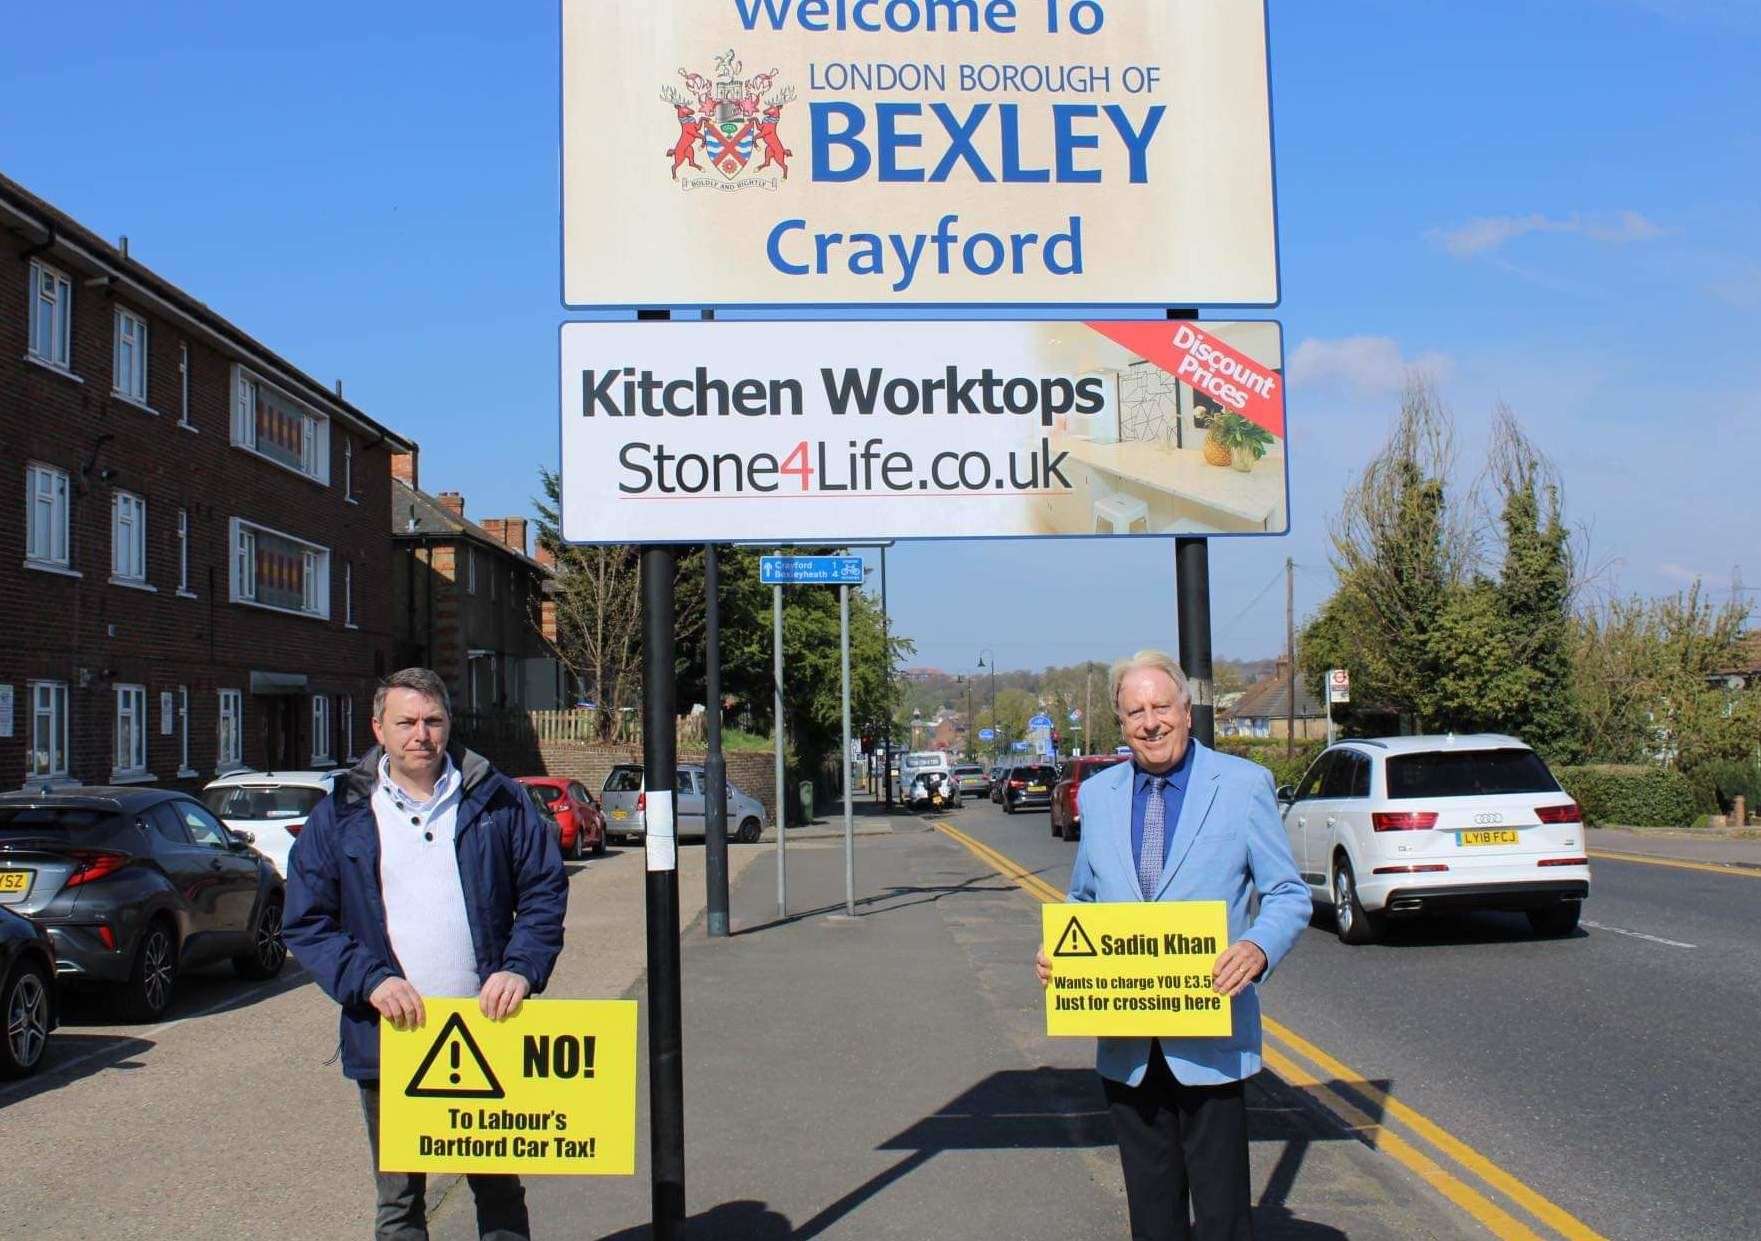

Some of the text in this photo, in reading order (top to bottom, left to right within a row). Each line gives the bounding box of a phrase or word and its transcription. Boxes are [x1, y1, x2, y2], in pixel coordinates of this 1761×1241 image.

[735, 0, 1017, 33] Welcome
[809, 63, 1161, 93] LONDON BOROUGH OF
[810, 101, 1167, 183] BEXLEY
[766, 214, 1084, 292] Crayford
[1172, 325, 1276, 400] Discount
[582, 365, 1105, 427] Kitchen Worktops
[1177, 354, 1249, 408] Prices
[618, 438, 1072, 493] Stone4Life.co.uk
[1465, 831, 1517, 844] LY18 FCJ
[1100, 933, 1217, 957] Sadiq Khan
[1054, 976, 1213, 991] Wants to charge YOU £3.5
[1055, 994, 1221, 1012] Just for crossing here
[523, 1034, 596, 1079] NO!
[448, 1108, 567, 1131] To Labour's
[419, 1135, 596, 1158] Dartford Car Tax!
